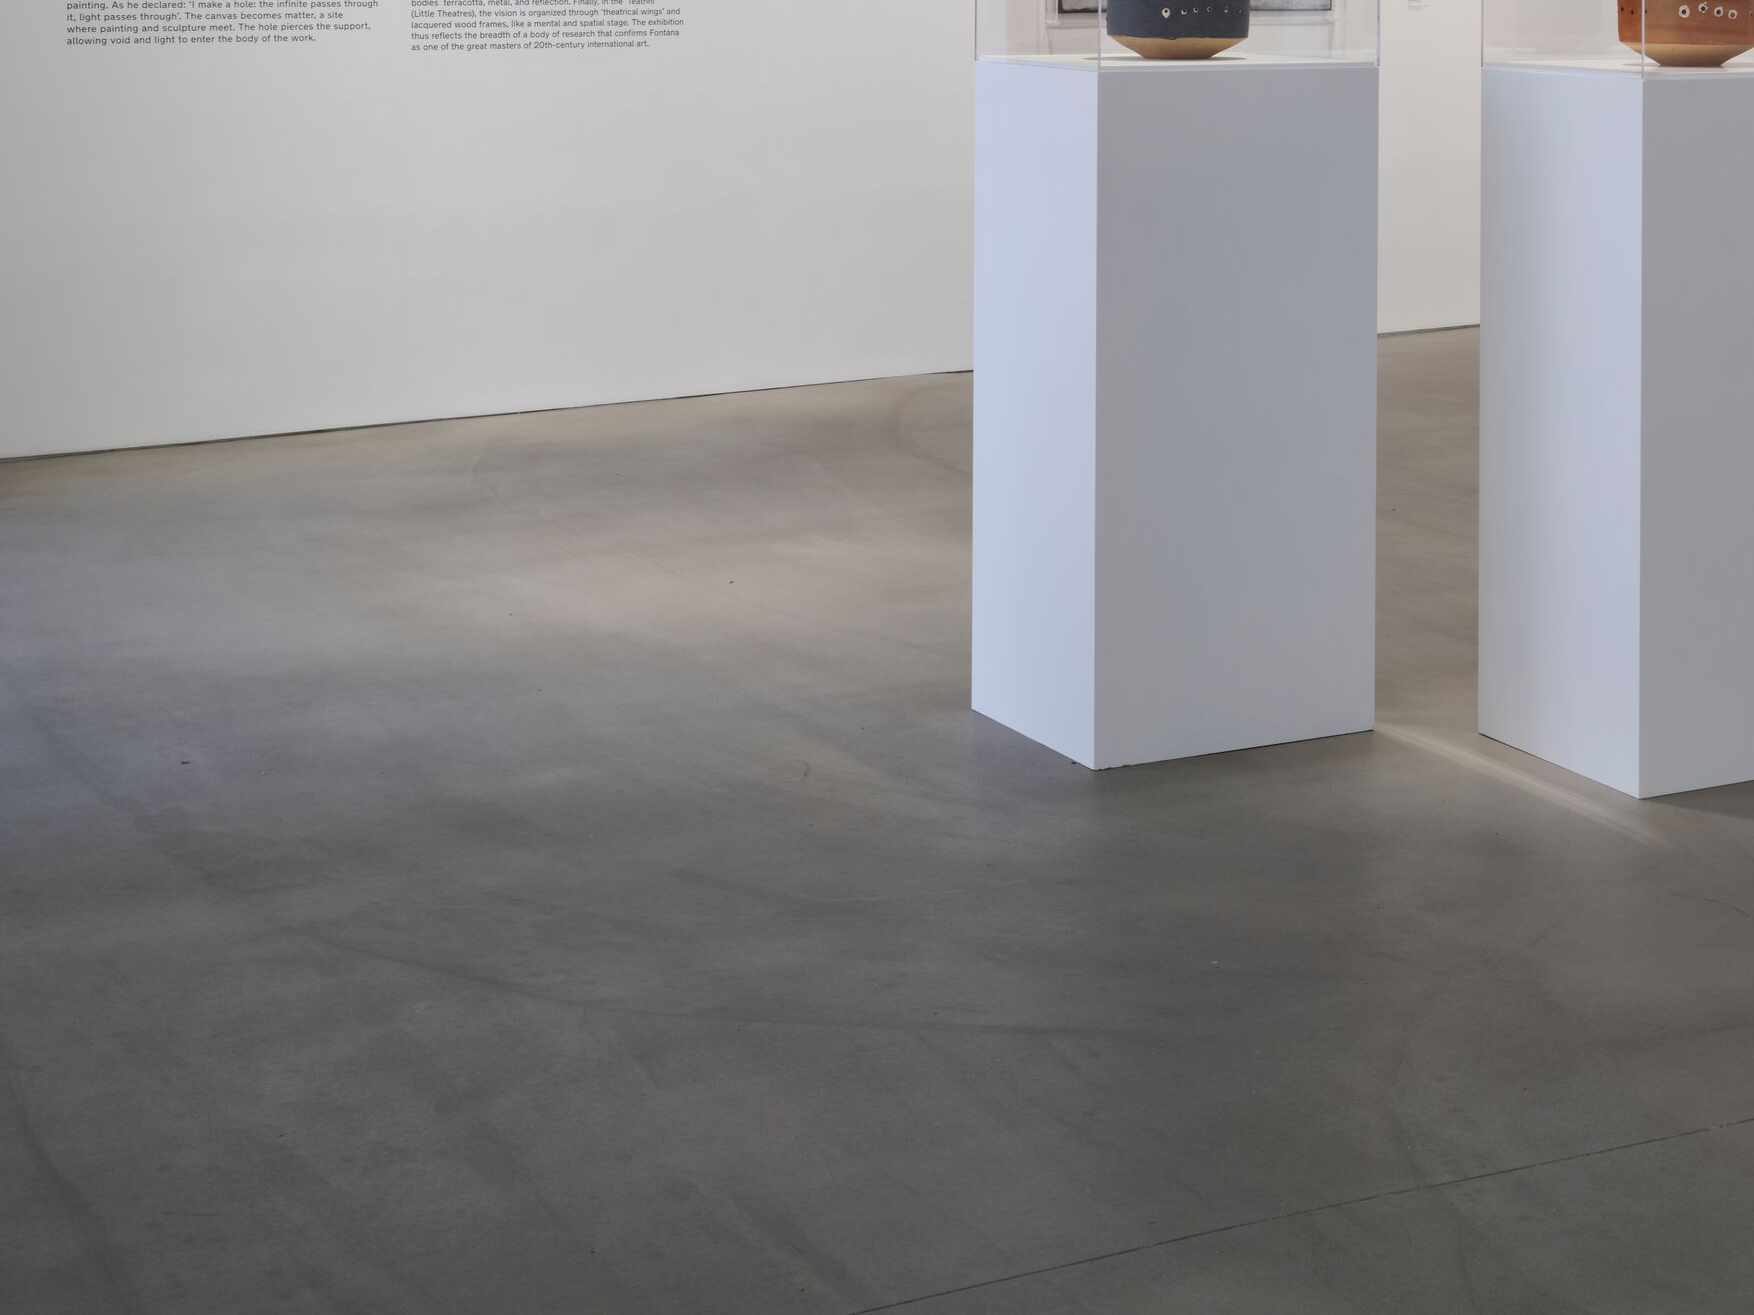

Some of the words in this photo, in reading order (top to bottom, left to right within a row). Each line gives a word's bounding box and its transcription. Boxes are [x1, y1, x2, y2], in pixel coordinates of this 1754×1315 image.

[67, 36, 107, 47] allowing
[110, 36, 131, 44] void
[134, 36, 151, 44] and
[154, 35, 175, 46] light
[178, 35, 188, 43] to
[191, 35, 215, 43] enter
[218, 34, 233, 43] the
[236, 34, 259, 44] body
[261, 34, 271, 42] of
[273, 34, 288, 42] the
[291, 33, 316, 42] work.
[411, 32, 430, 40] thus
[431, 31, 462, 40] reflects
[464, 31, 478, 39] the
[479, 30, 511, 39] breadth
[512, 30, 521, 39] of
[530, 30, 550, 40] body
[551, 30, 560, 38] of
[562, 29, 595, 38] research
[597, 29, 613, 38] that
[614, 29, 647, 37] confirms
[649, 28, 679, 37] Fontana
